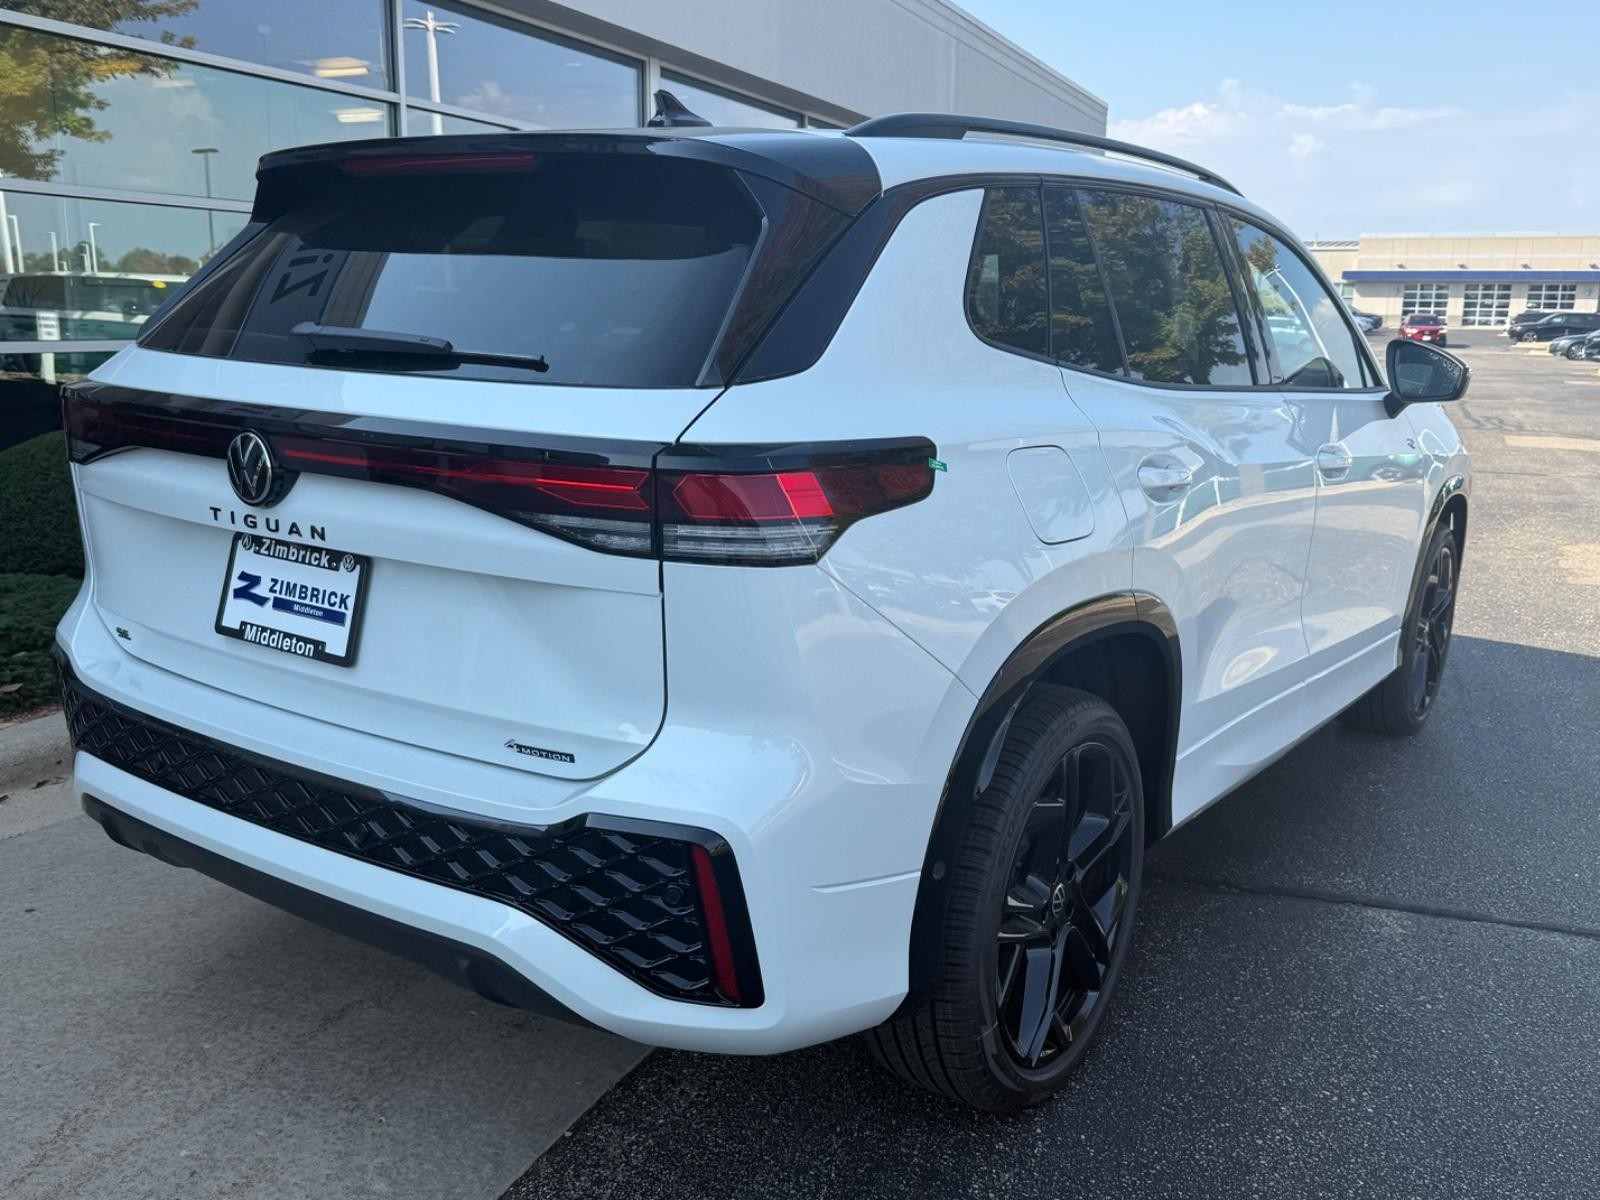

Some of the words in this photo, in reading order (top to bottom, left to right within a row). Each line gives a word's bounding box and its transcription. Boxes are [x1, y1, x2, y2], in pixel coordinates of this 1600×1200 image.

[209, 506, 327, 542] TIGUAN
[260, 539, 329, 569] Zimbrick
[269, 577, 352, 611] ZIMBRICK
[293, 603, 324, 618] Middleton
[244, 623, 315, 657] Middleton
[504, 738, 572, 763] 4MOTION
